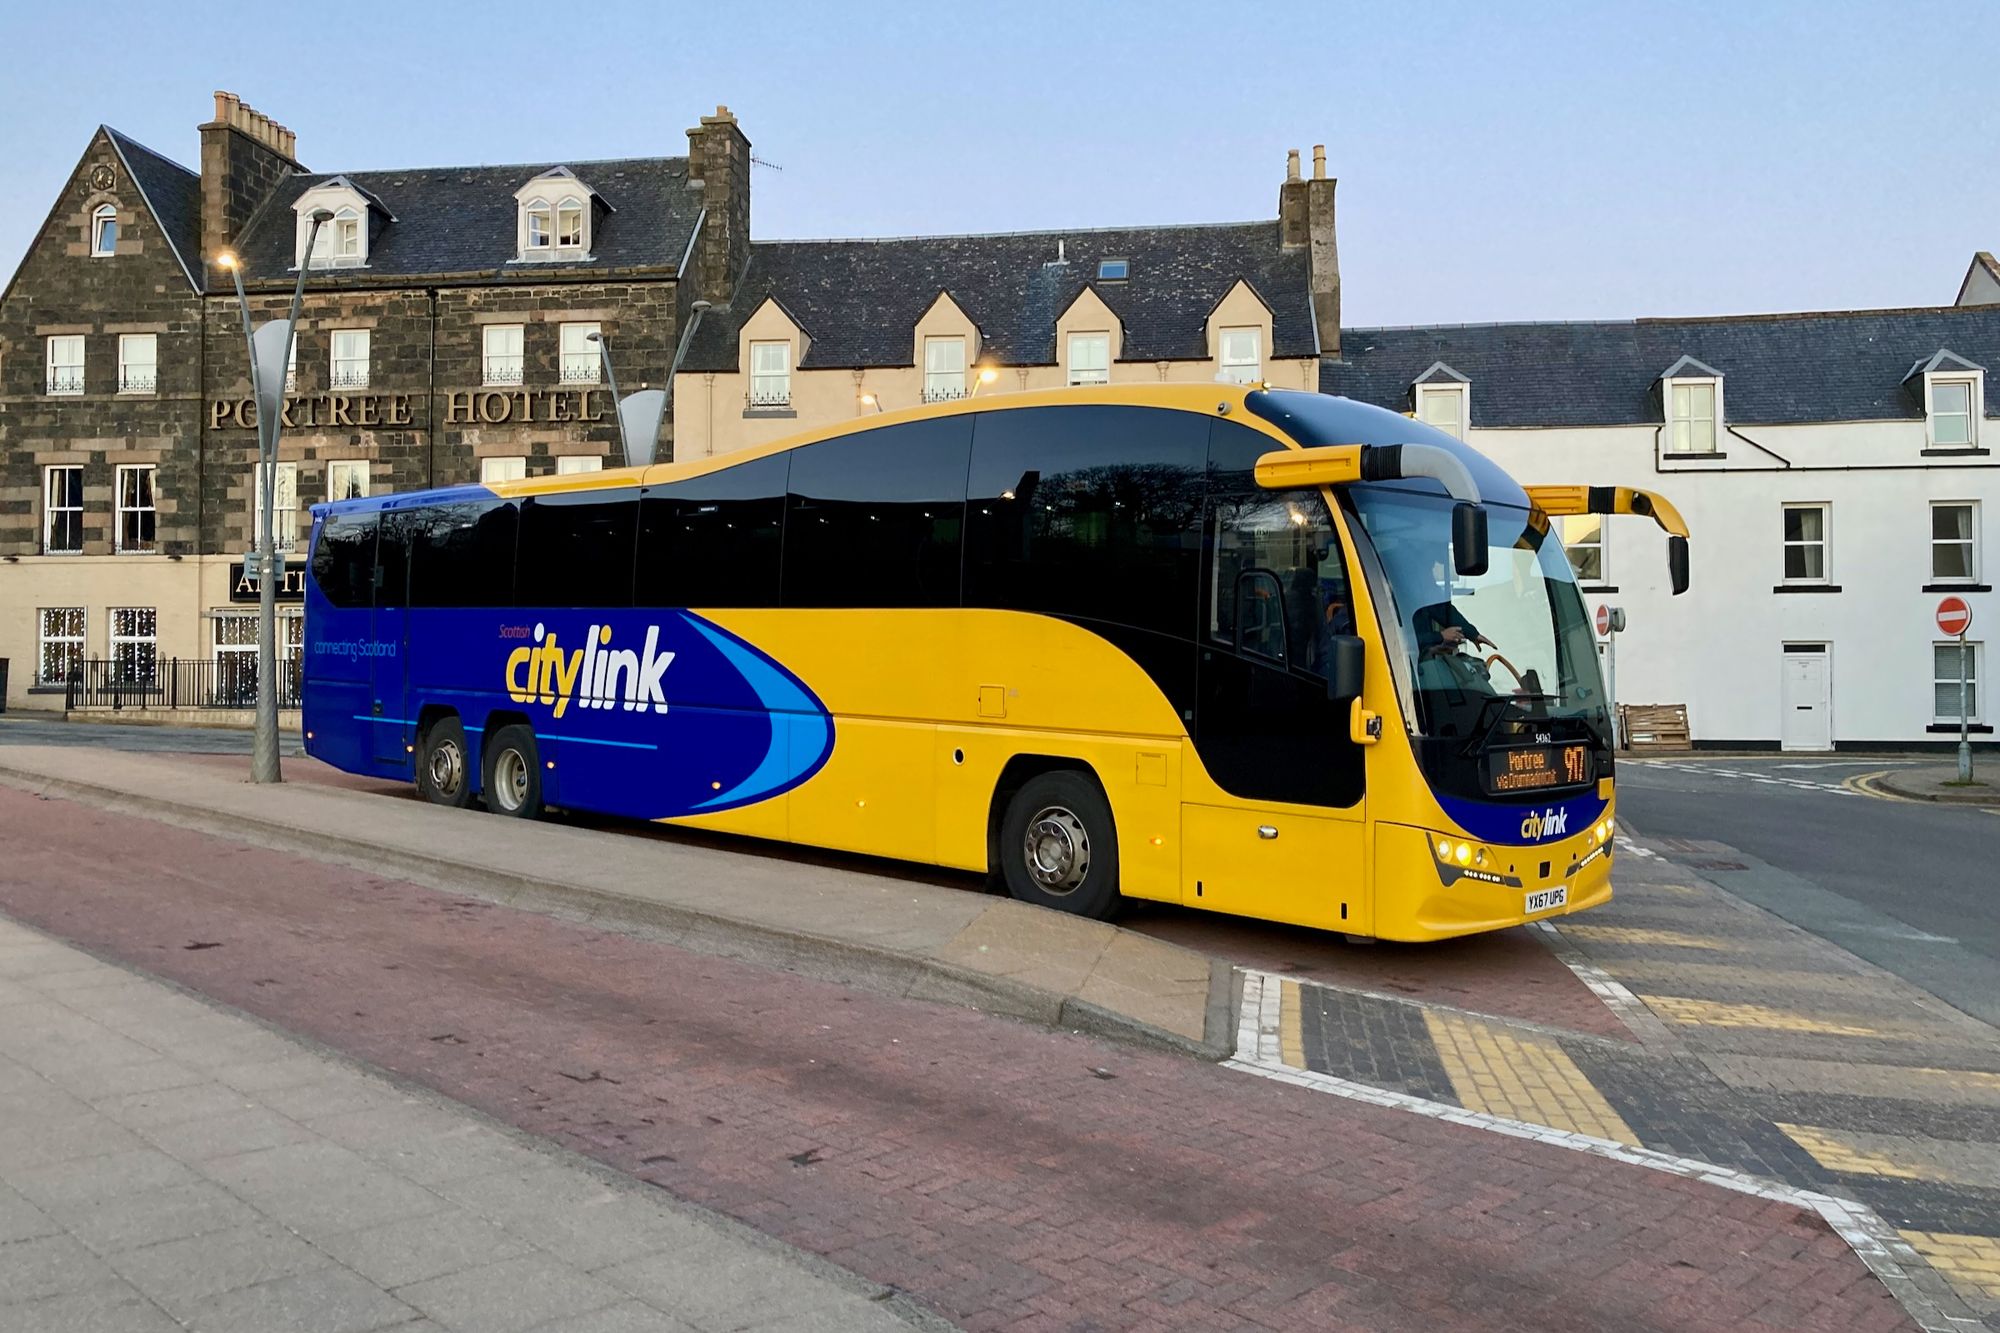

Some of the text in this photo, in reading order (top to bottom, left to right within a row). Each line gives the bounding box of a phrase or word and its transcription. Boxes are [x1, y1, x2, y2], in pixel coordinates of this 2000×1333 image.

[209, 390, 602, 429] PORTREE HOTEL
[499, 624, 530, 638] Scottish
[314, 638, 396, 662] connecting Scotland
[506, 622, 675, 718] citylink
[1508, 746, 1584, 782] Portree 917
[1521, 806, 1568, 841] citylink
[1529, 889, 1564, 910] YX67 UPG
